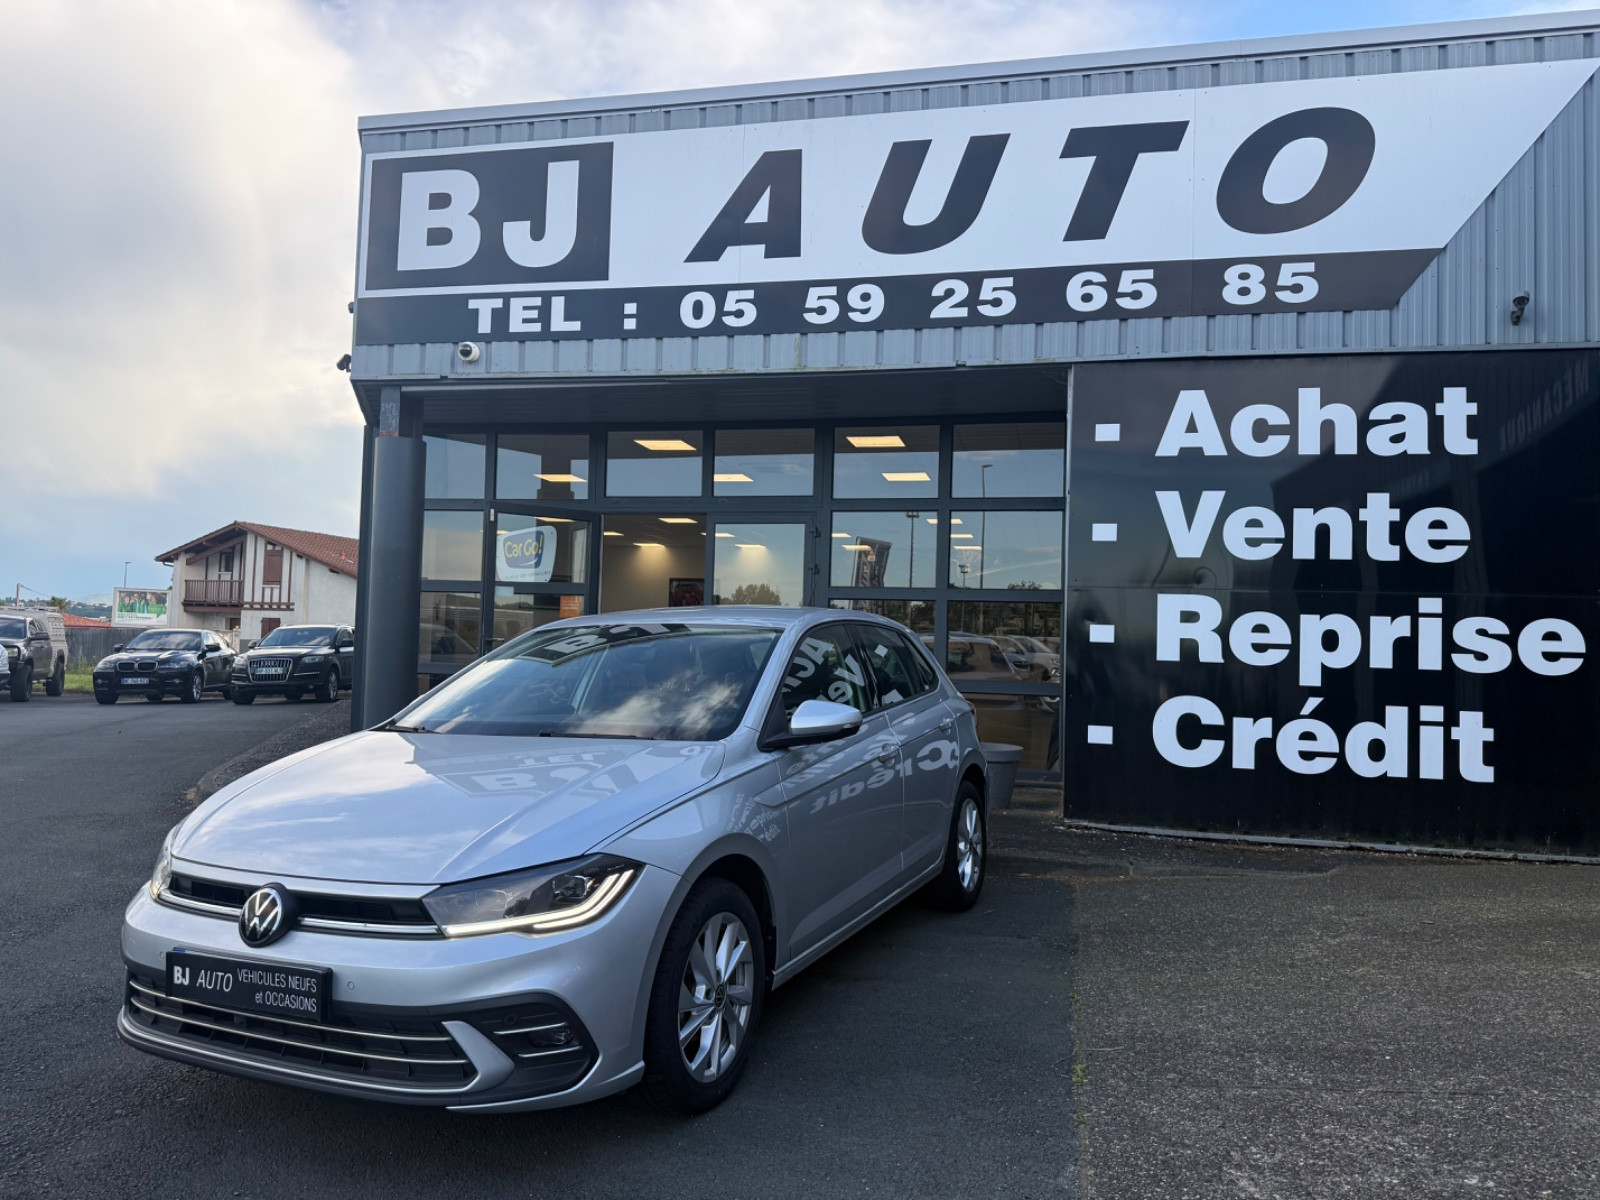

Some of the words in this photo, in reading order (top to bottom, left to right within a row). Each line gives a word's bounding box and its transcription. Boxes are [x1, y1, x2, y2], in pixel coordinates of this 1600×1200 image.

[397, 159, 581, 271] BJ
[682, 106, 1377, 264] AUTO
[467, 296, 581, 334] TEL
[679, 290, 758, 329] 05
[802, 283, 885, 325] 59
[929, 276, 1017, 319] 25
[1065, 269, 1159, 313] 65
[1221, 262, 1320, 306] 85
[1154, 387, 1479, 458] Achat
[1154, 490, 1471, 563] Vente
[1156, 593, 1587, 687] Reprise
[1152, 695, 1495, 783] Crédit
[173, 966, 190, 986] BJ
[196, 969, 233, 992] AUTO
[237, 968, 287, 988] VEHICULES
[288, 975, 317, 993] NEUFS
[255, 991, 263, 1005] et
[265, 991, 317, 1013] OCCASIONS
